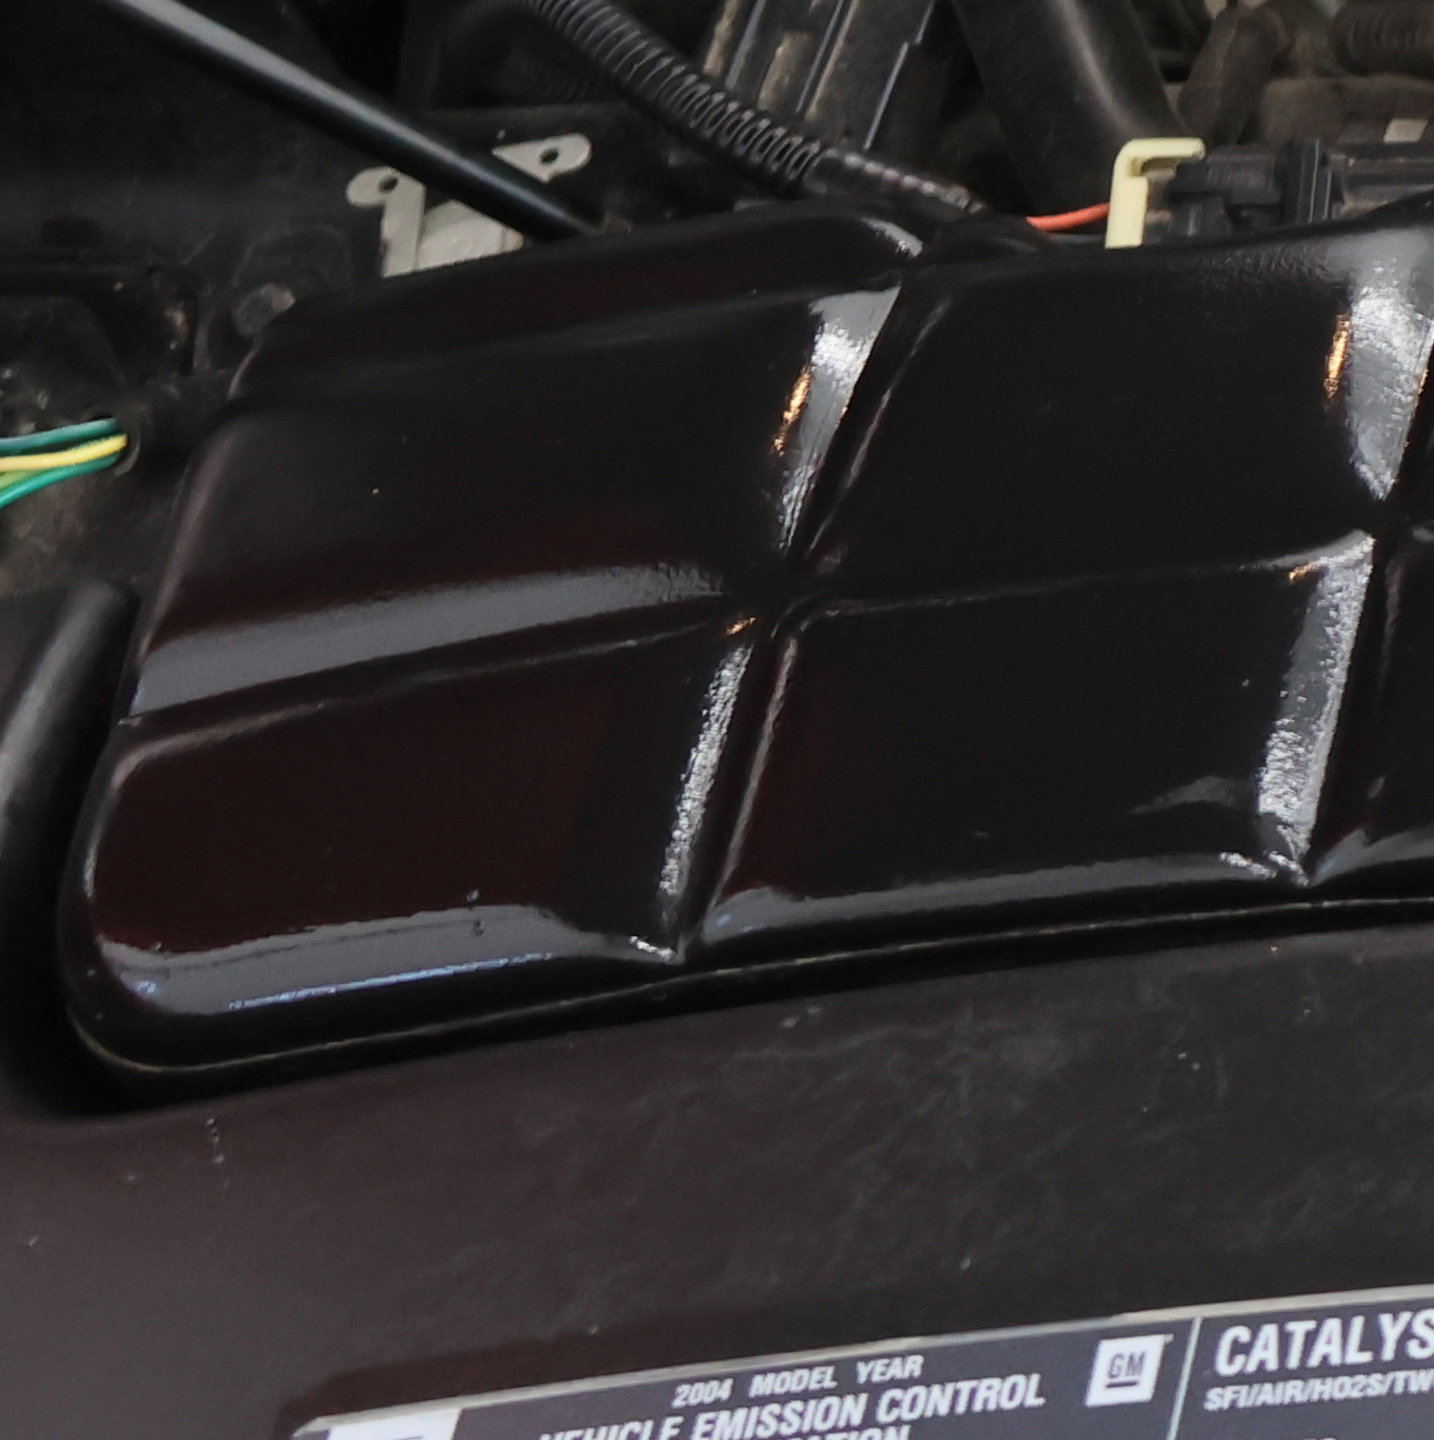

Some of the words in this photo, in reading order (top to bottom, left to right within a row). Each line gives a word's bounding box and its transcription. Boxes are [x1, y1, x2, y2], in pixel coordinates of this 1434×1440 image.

[672, 1378, 734, 1409] 2004
[748, 1365, 838, 1399] MODEL
[856, 1354, 924, 1385] YEAR
[1105, 1349, 1149, 1382] GM
[691, 1393, 869, 1440] EMISSION
[876, 1373, 1047, 1424] CONTROL
